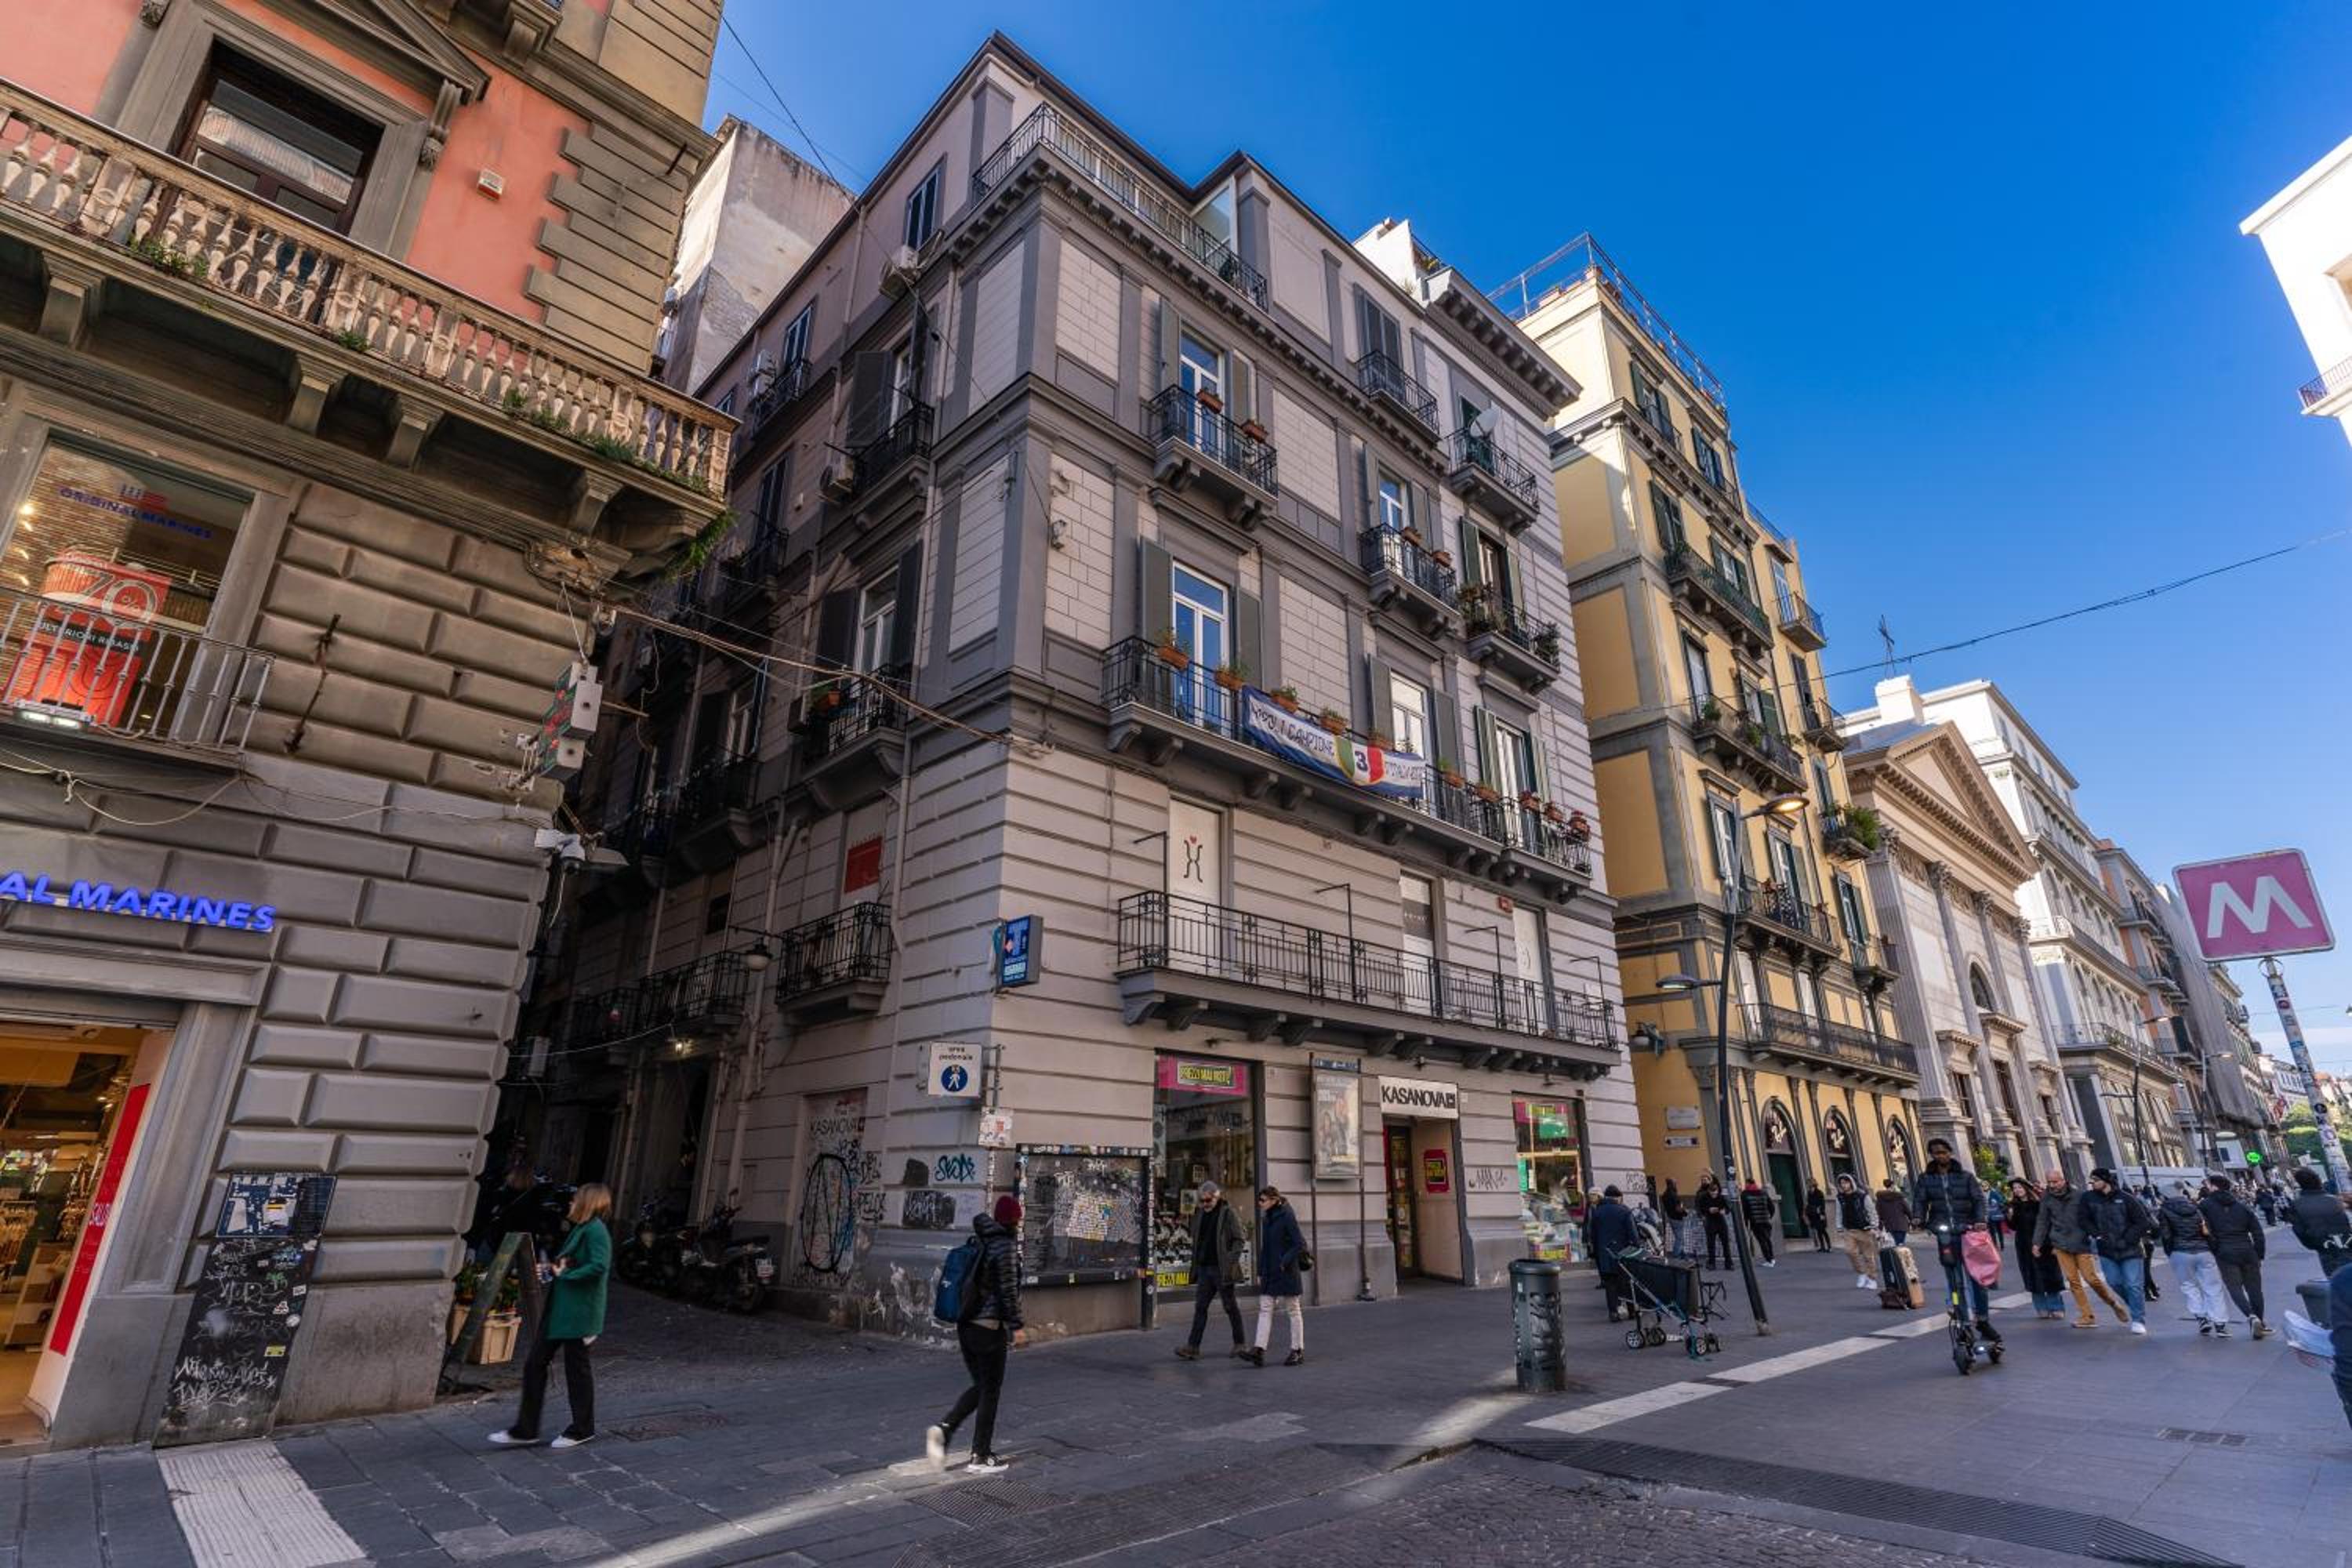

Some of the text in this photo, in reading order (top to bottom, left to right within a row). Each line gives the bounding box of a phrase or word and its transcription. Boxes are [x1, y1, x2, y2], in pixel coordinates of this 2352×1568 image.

[1355, 750, 1368, 772] 3
[68, 879, 277, 931] MARINES
[2207, 876, 2312, 938] M
[1381, 1085, 1446, 1107] KASANOVA
